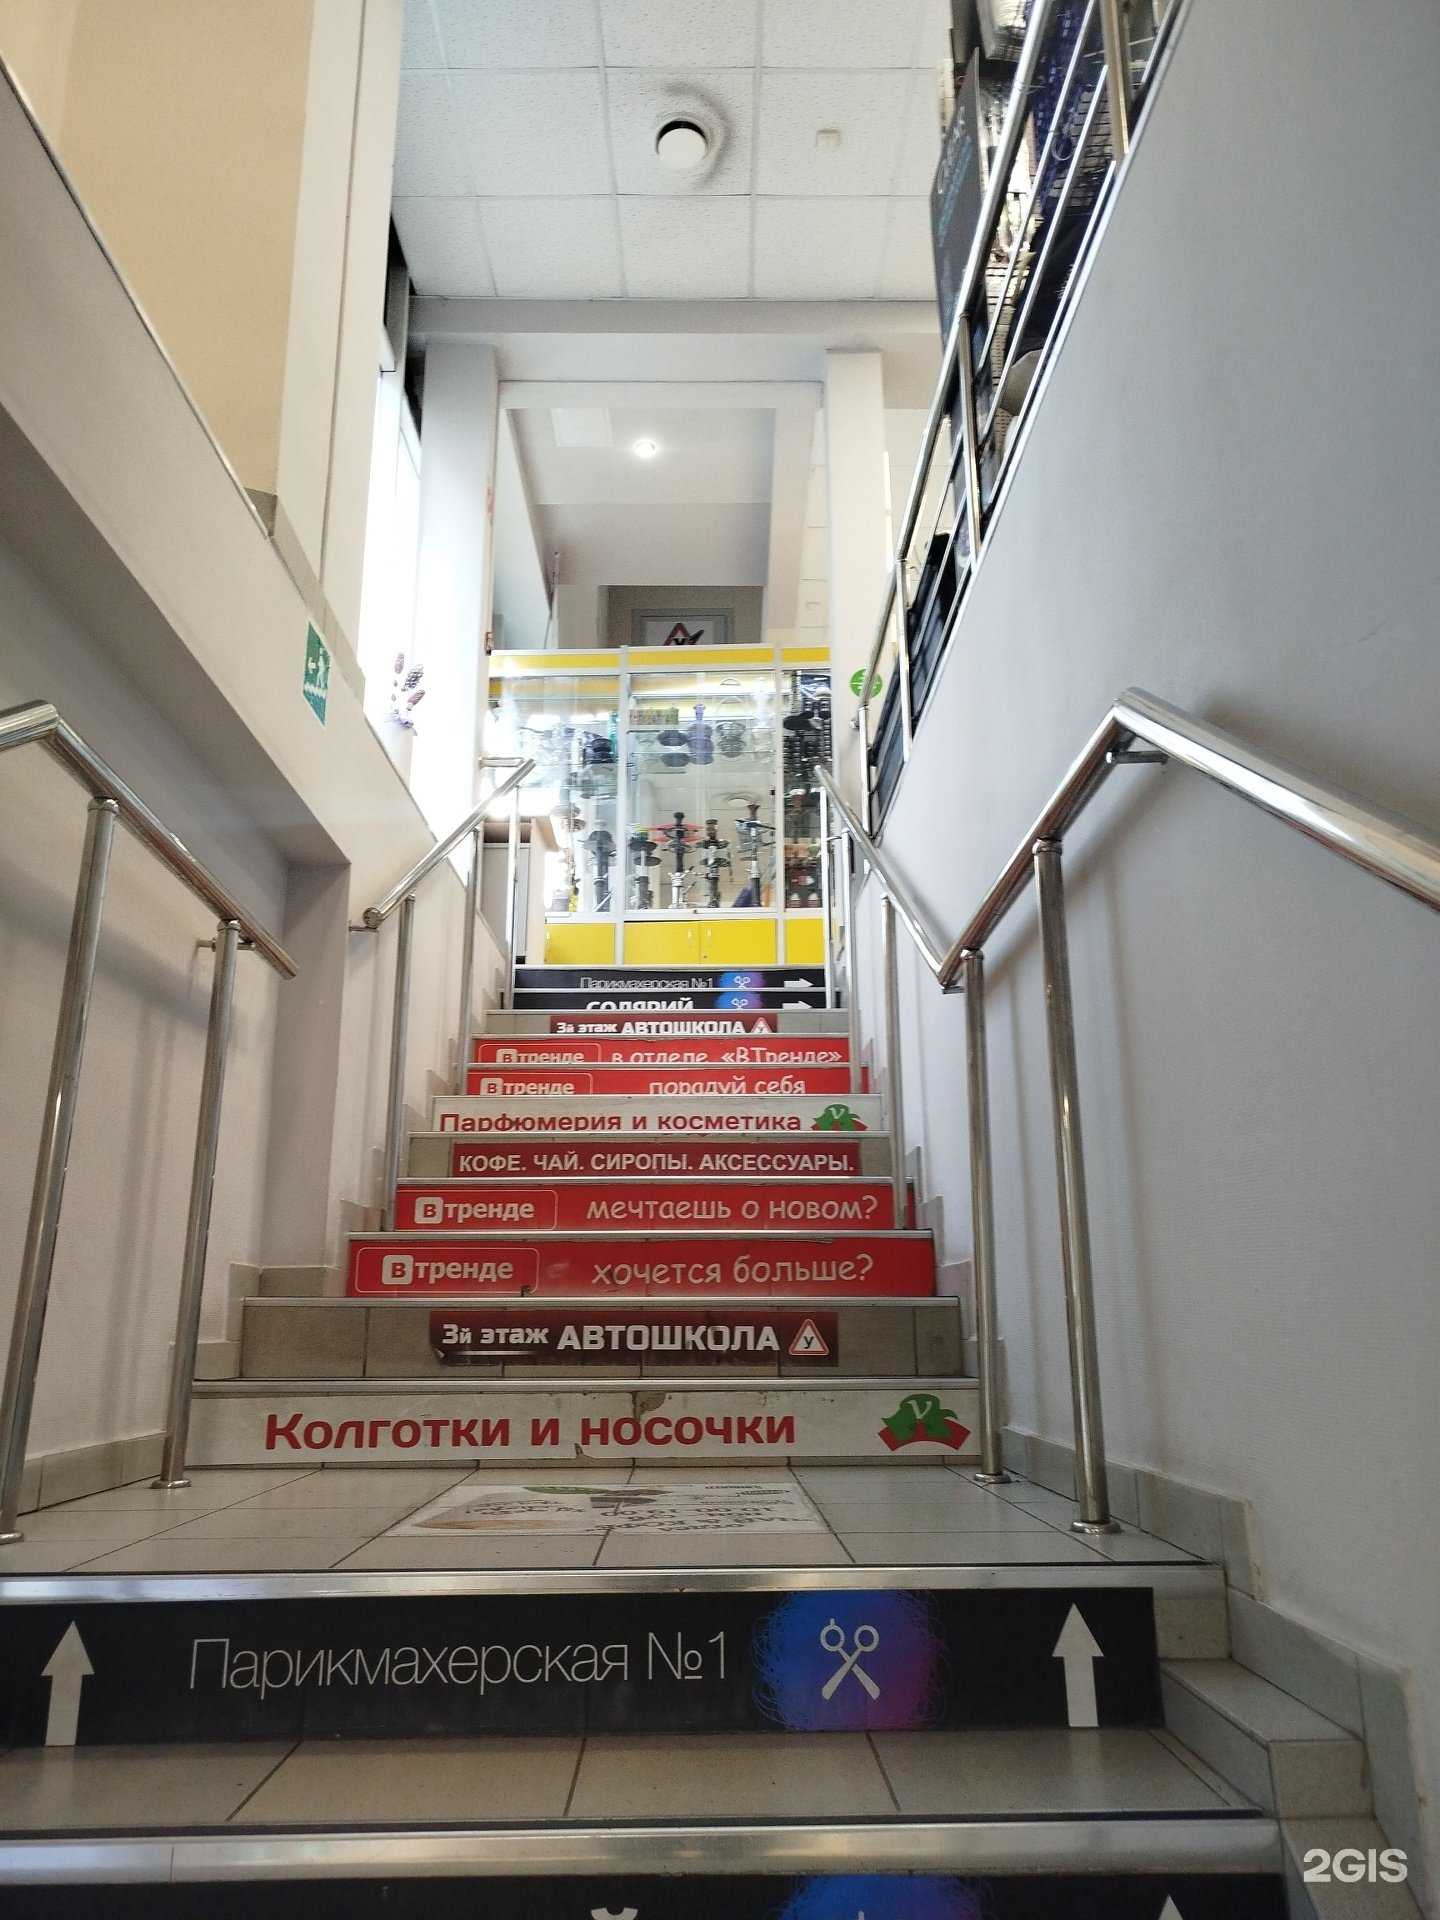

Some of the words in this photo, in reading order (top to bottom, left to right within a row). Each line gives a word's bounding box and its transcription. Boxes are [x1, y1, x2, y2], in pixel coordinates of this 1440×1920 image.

[577, 1023, 617, 1033] этаж
[621, 1021, 746, 1034] АВТОШКОЛА
[754, 1074, 806, 1095] себя
[440, 1113, 622, 1131] Парфюмерия
[632, 1116, 647, 1130] и
[658, 1115, 801, 1130] косметика
[459, 1155, 527, 1172] КОФЕ.
[534, 1151, 585, 1171] ЧАЙ.
[590, 1153, 693, 1171] СИРОПЫ.
[699, 1153, 855, 1171] АКСЕССУАРЫ.
[586, 1200, 731, 1221] мечтаешь
[742, 1202, 759, 1220] о
[769, 1195, 878, 1221] новом?
[591, 1259, 722, 1286] хочется
[732, 1253, 875, 1283] больше?
[441, 1323, 472, 1344] 3й
[480, 1326, 549, 1345] этаж
[556, 1324, 780, 1351] АВТОШКОЛА
[264, 1413, 510, 1451] Колготки
[531, 1418, 560, 1447] и
[581, 1414, 796, 1447] носочки
[190, 1638, 628, 1700] Парикмахерская
[648, 1631, 726, 1681] №1
